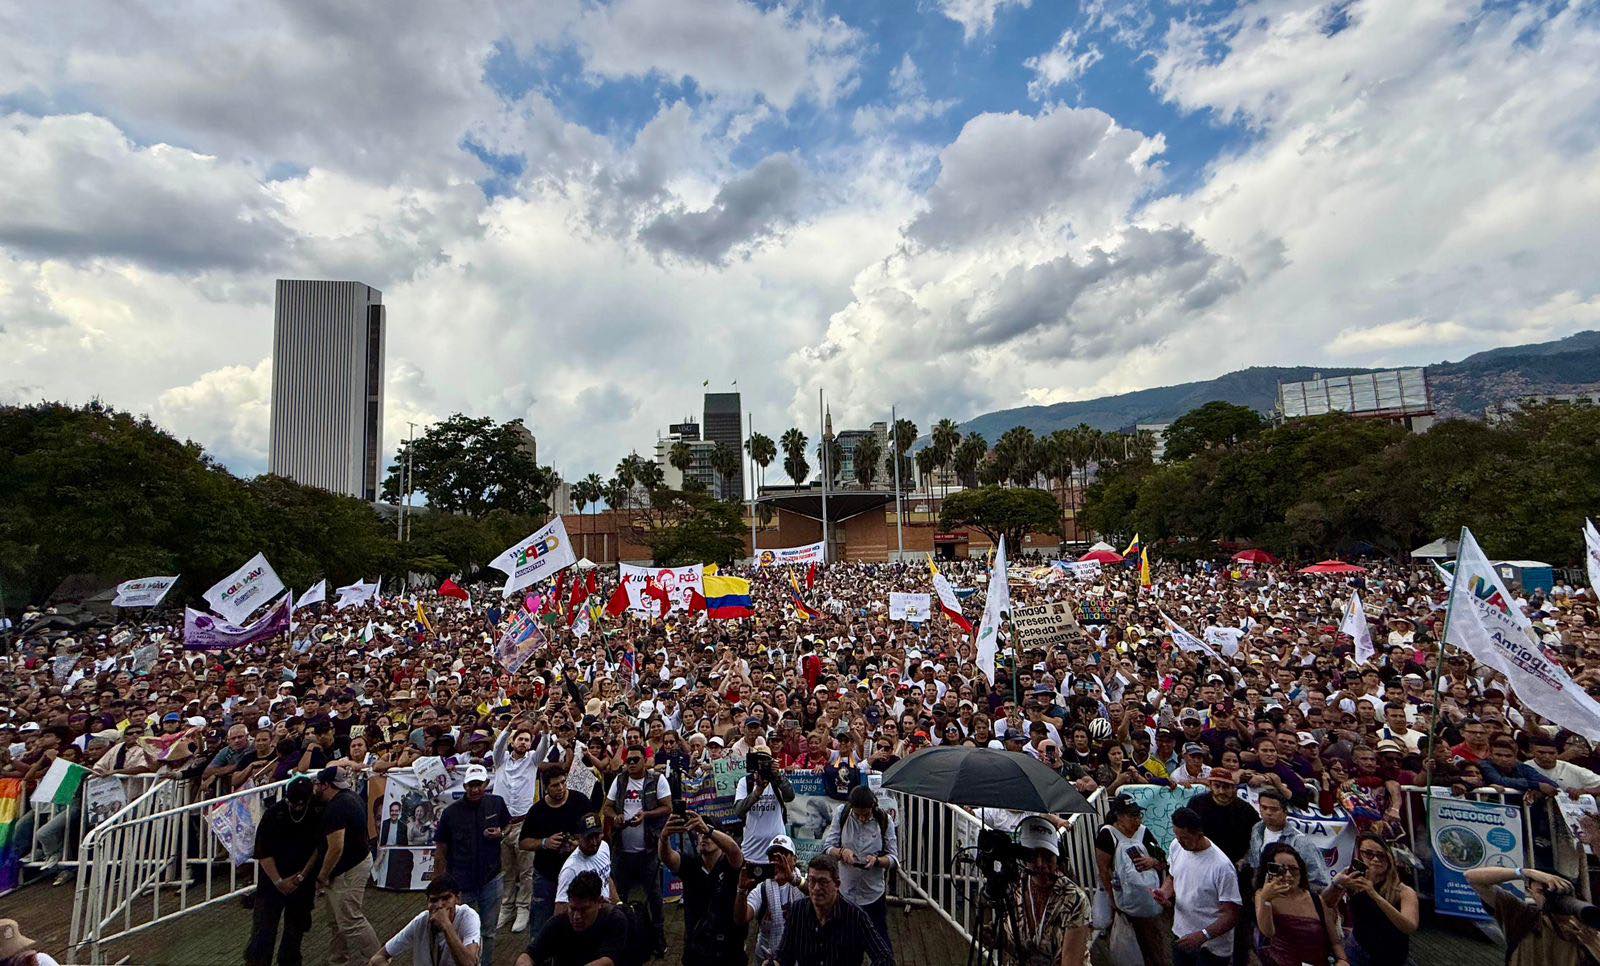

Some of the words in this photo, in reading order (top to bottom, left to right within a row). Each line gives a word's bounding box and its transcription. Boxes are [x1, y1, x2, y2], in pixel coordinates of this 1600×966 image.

[1015, 614, 1062, 629] presente
[1019, 625, 1056, 639] cepeda
[1022, 630, 1081, 648] presidente
[714, 763, 726, 774] EL
[717, 780, 728, 791] ES
[800, 784, 817, 792] 1989
[1438, 807, 1456, 820] LA
[1455, 810, 1505, 826] GEORGIA
